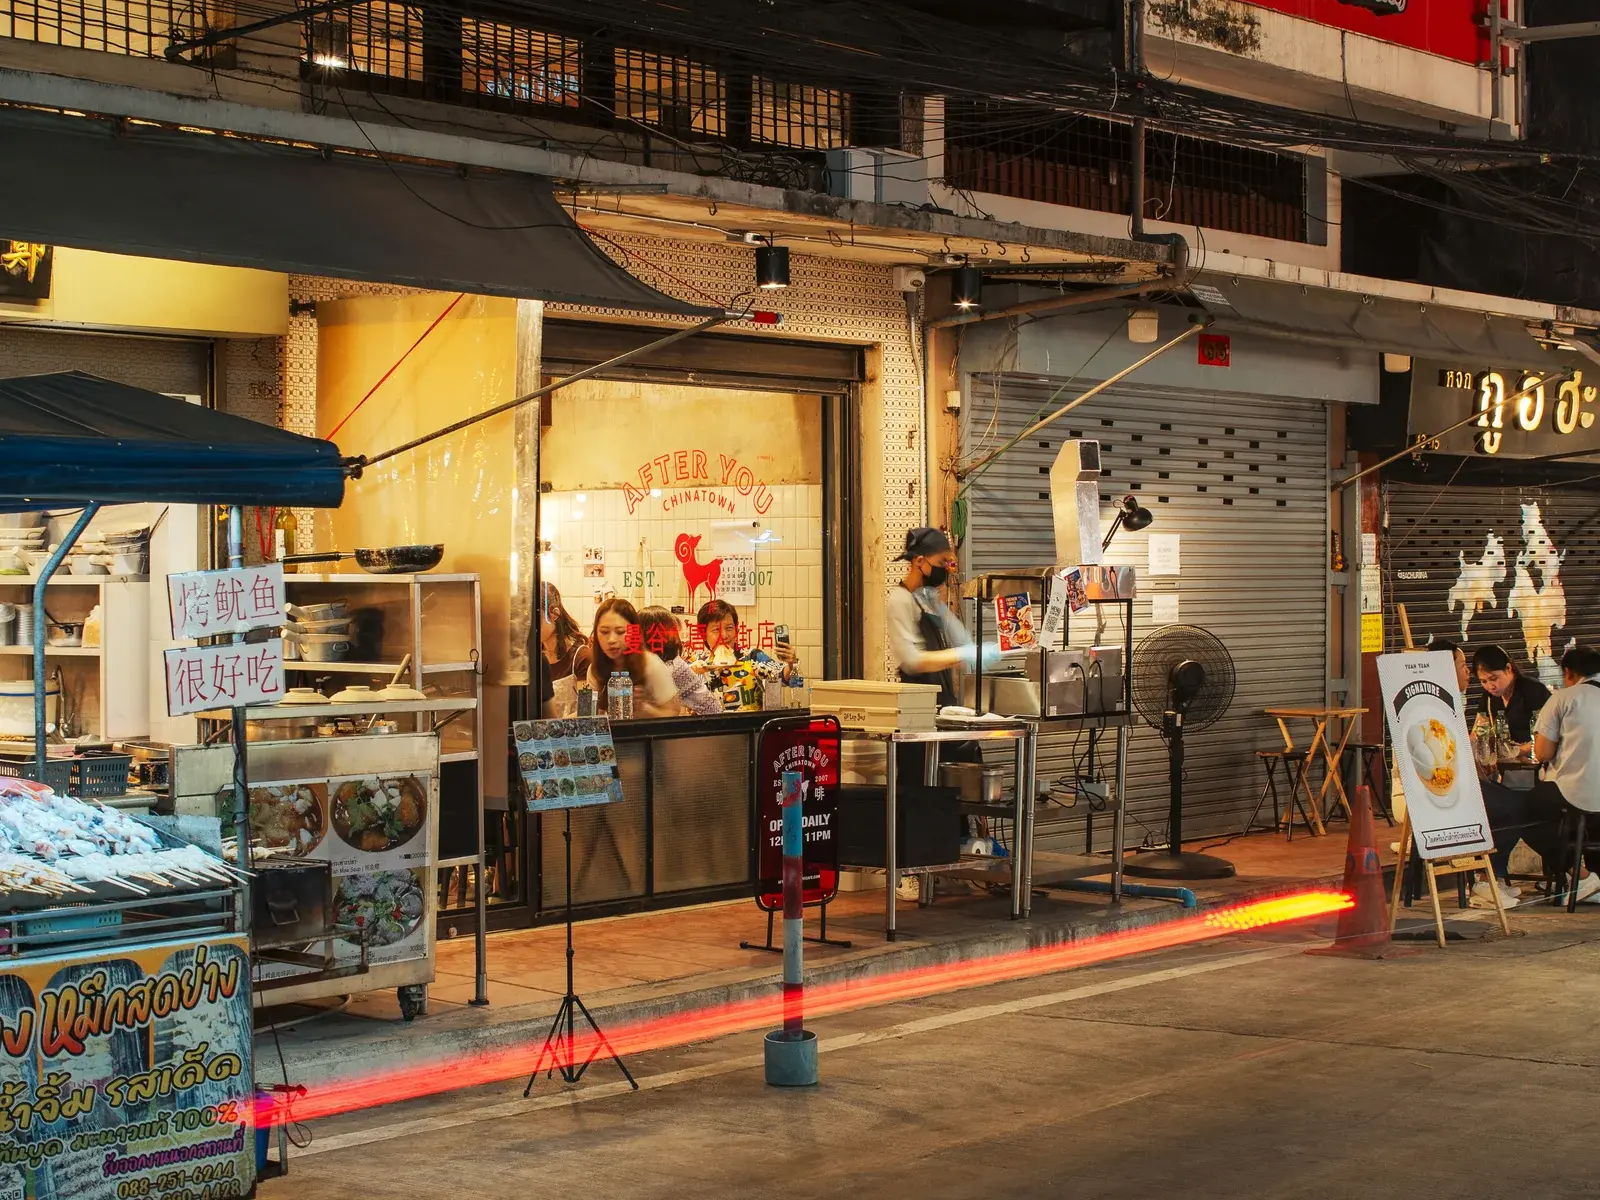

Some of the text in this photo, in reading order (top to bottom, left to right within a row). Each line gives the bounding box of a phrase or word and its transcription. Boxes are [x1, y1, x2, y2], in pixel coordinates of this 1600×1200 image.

[622, 450, 774, 515] AFTER YOU
[662, 490, 735, 514] CHINATOWN
[622, 571, 773, 588] EST. 2007
[179, 574, 281, 629] 烤鱿鱼
[174, 648, 280, 706] 很好吃
[1404, 682, 1440, 699] SIGNATURE
[773, 744, 829, 773] AFTER YOU
[785, 759, 816, 771] CHINATOWN
[773, 779, 782, 788] ES
[801, 813, 831, 828] DAILY
[804, 830, 831, 842] 11PM
[171, 1100, 239, 1133] 100%
[117, 1160, 235, 1200] 088-251-6244
